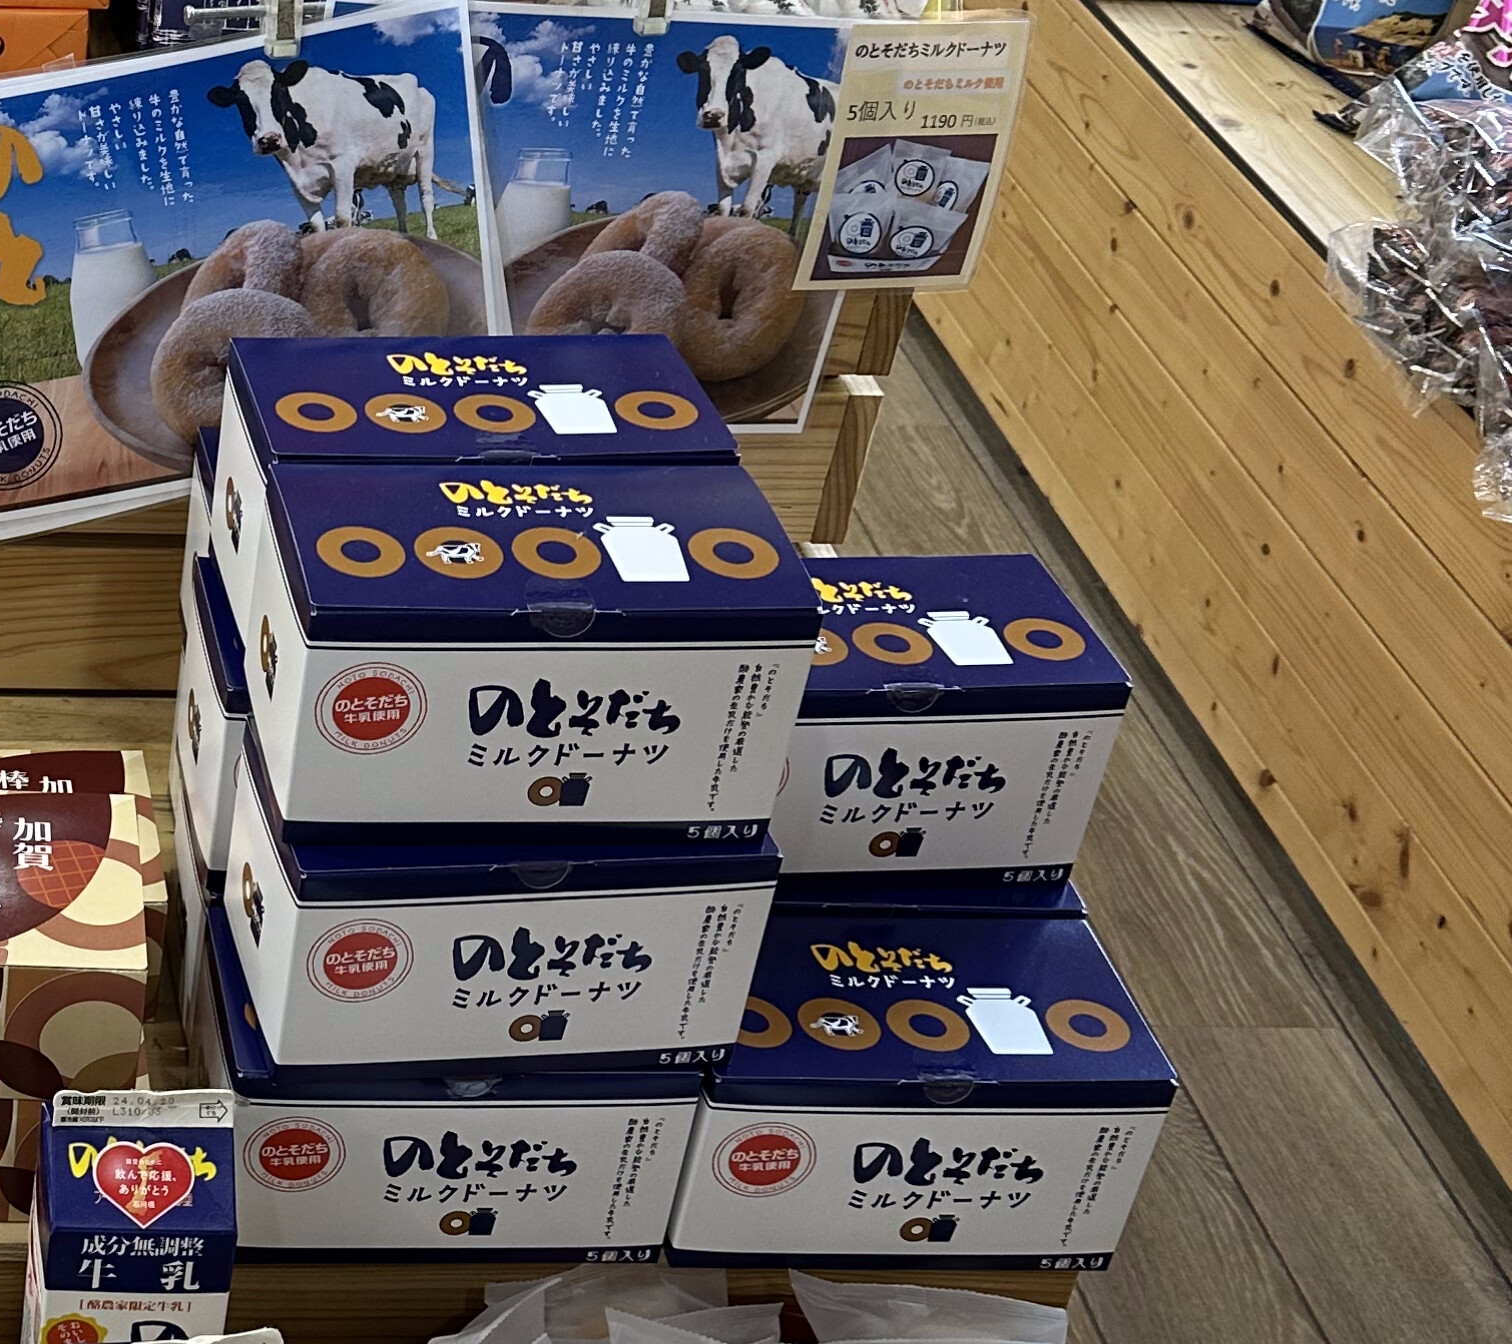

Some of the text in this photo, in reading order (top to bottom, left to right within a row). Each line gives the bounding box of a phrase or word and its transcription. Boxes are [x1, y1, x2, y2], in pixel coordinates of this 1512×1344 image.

[855, 41, 1008, 59] のとそだちミルクドーナツ
[581, 43, 602, 91] やさしい
[591, 42, 621, 138] 練り込みました。
[602, 43, 637, 157] 牛のミルクを生地に
[620, 43, 655, 158] 豊かな自然で育った
[846, 100, 917, 122] 5個入り
[108, 103, 128, 151] やさしい
[89, 105, 117, 190] 甘さが美味しい
[128, 96, 156, 190] 練り込みました。
[148, 93, 176, 207] 牛のミルクを生地に
[168, 88, 195, 203] 豊かな自然で育った
[439, 479, 594, 506] のとそだち
[456, 504, 595, 519] ミルクドーナツ
[335, 693, 408, 713] のとそだち
[468, 677, 682, 739] のとそだち
[343, 709, 401, 725] 牛乳使用
[467, 742, 671, 769] ミルクドーナツ
[824, 747, 1007, 799] のとそだち
[819, 800, 996, 825] ミルクドーナツ
[687, 822, 759, 842] 5個入り
[12, 816, 55, 873] 加賀
[1002, 866, 1065, 884] 5個入り
[452, 927, 654, 981] のとそだち
[333, 959, 390, 976] 牛乳使用
[829, 973, 956, 990] ミルクドーナツ
[451, 980, 643, 1010] ミルクドーナツ
[659, 1047, 727, 1066] 5個入り
[60, 1095, 107, 1107] 賞味期限
[268, 1153, 324, 1170] 牛乳使用
[383, 1130, 579, 1181] のとそだち
[738, 1159, 792, 1173] 牛乳使用
[853, 1138, 1045, 1187] のとそだち
[114, 1169, 177, 1182] 飲んで応援、
[118, 1184, 170, 1196] ありがとう
[383, 1182, 569, 1205] ミルクドーナツ
[848, 1190, 1032, 1211] ミルクドーナツ
[132, 1200, 156, 1209] 石川県
[80, 1234, 206, 1257] 成分無調整
[586, 1247, 652, 1264] 5個入り
